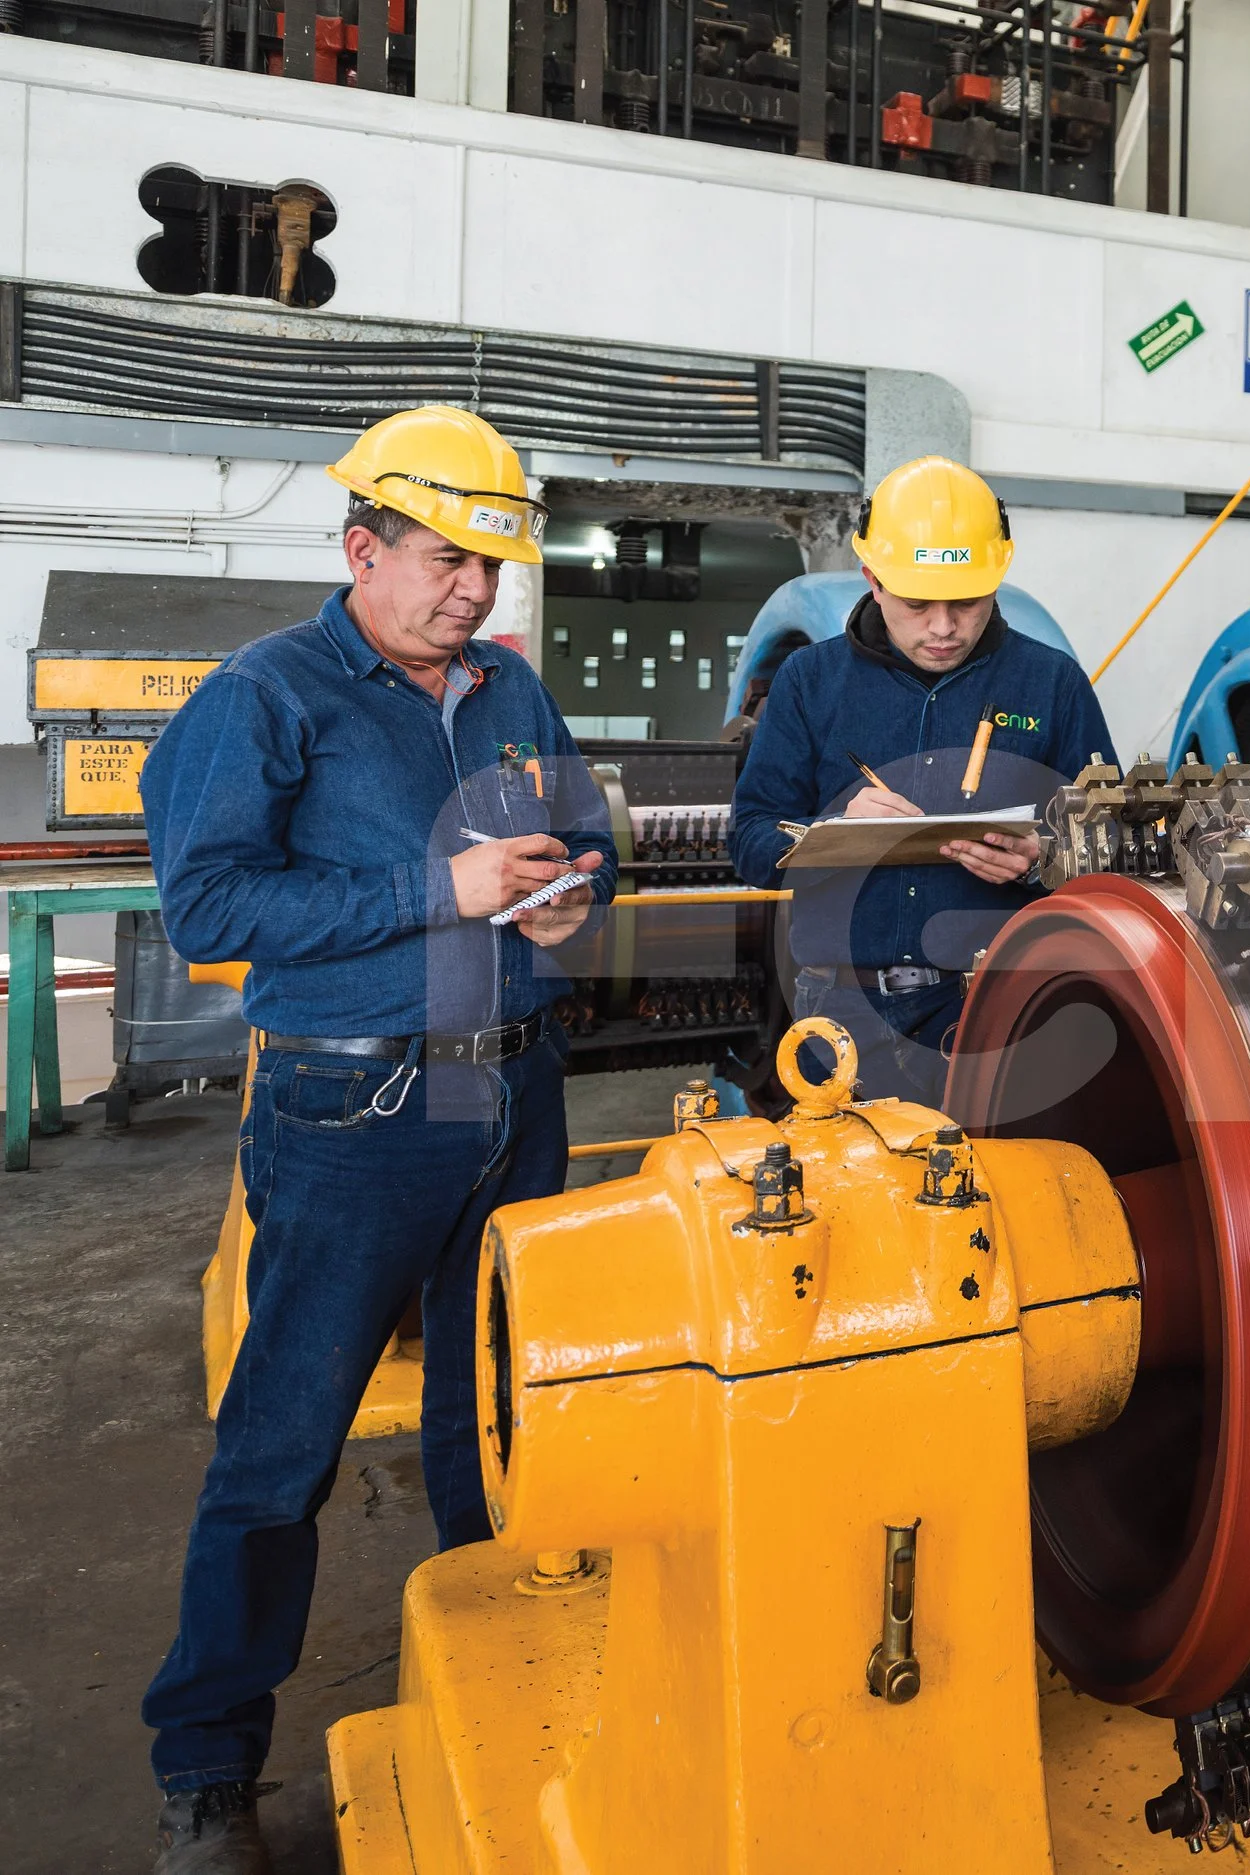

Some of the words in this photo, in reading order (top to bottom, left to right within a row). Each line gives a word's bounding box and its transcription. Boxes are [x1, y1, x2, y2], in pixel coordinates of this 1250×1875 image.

[142, 675, 205, 696] PELIG
[80, 744, 134, 755] PARA
[80, 758, 128, 769] ESTE
[80, 771, 126, 784] QUE,
